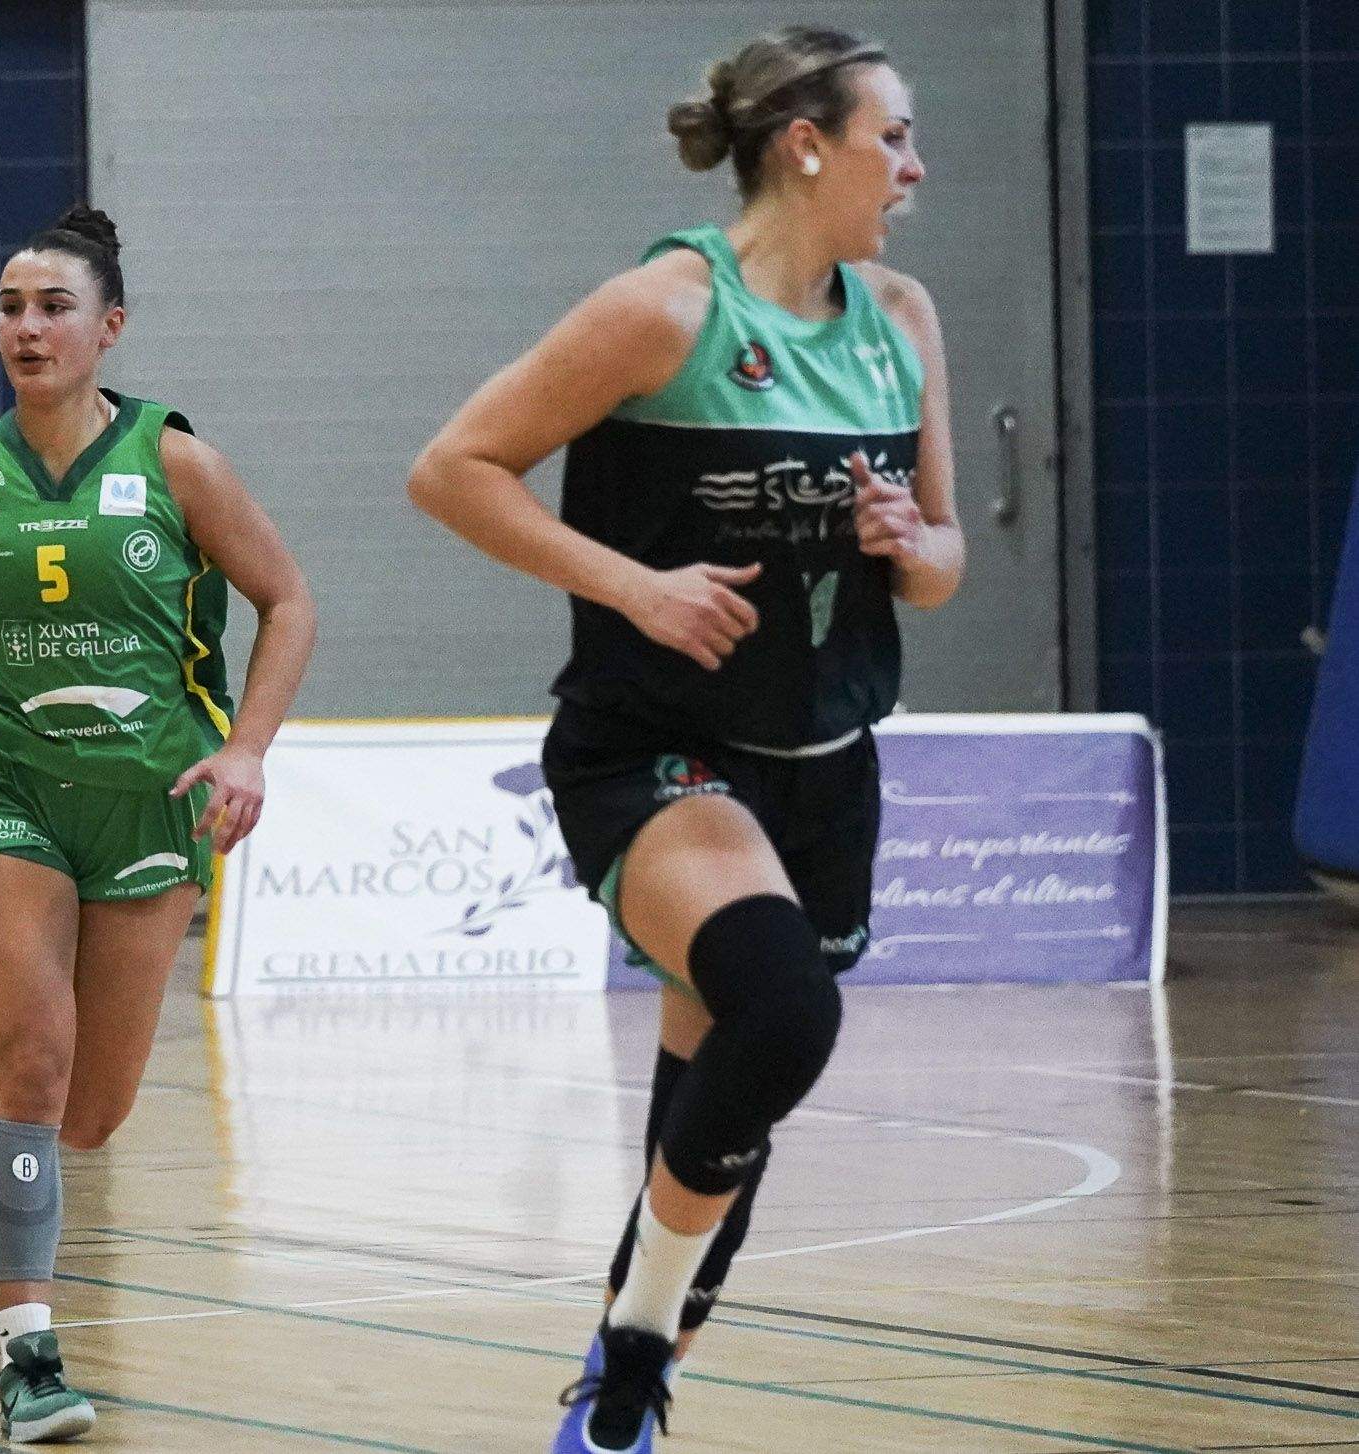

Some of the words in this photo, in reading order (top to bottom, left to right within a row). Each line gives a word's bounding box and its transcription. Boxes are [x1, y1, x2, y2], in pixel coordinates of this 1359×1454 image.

[36, 544, 70, 603] 5
[38, 622, 100, 639] XUNTA
[38, 642, 61, 658] DE
[65, 634, 142, 657] GALICIA
[390, 820, 495, 859] SAN
[940, 829, 1131, 871] importantes
[255, 857, 497, 898] MARCOS
[973, 873, 1015, 906] el
[262, 945, 576, 977] CREMATORIO
